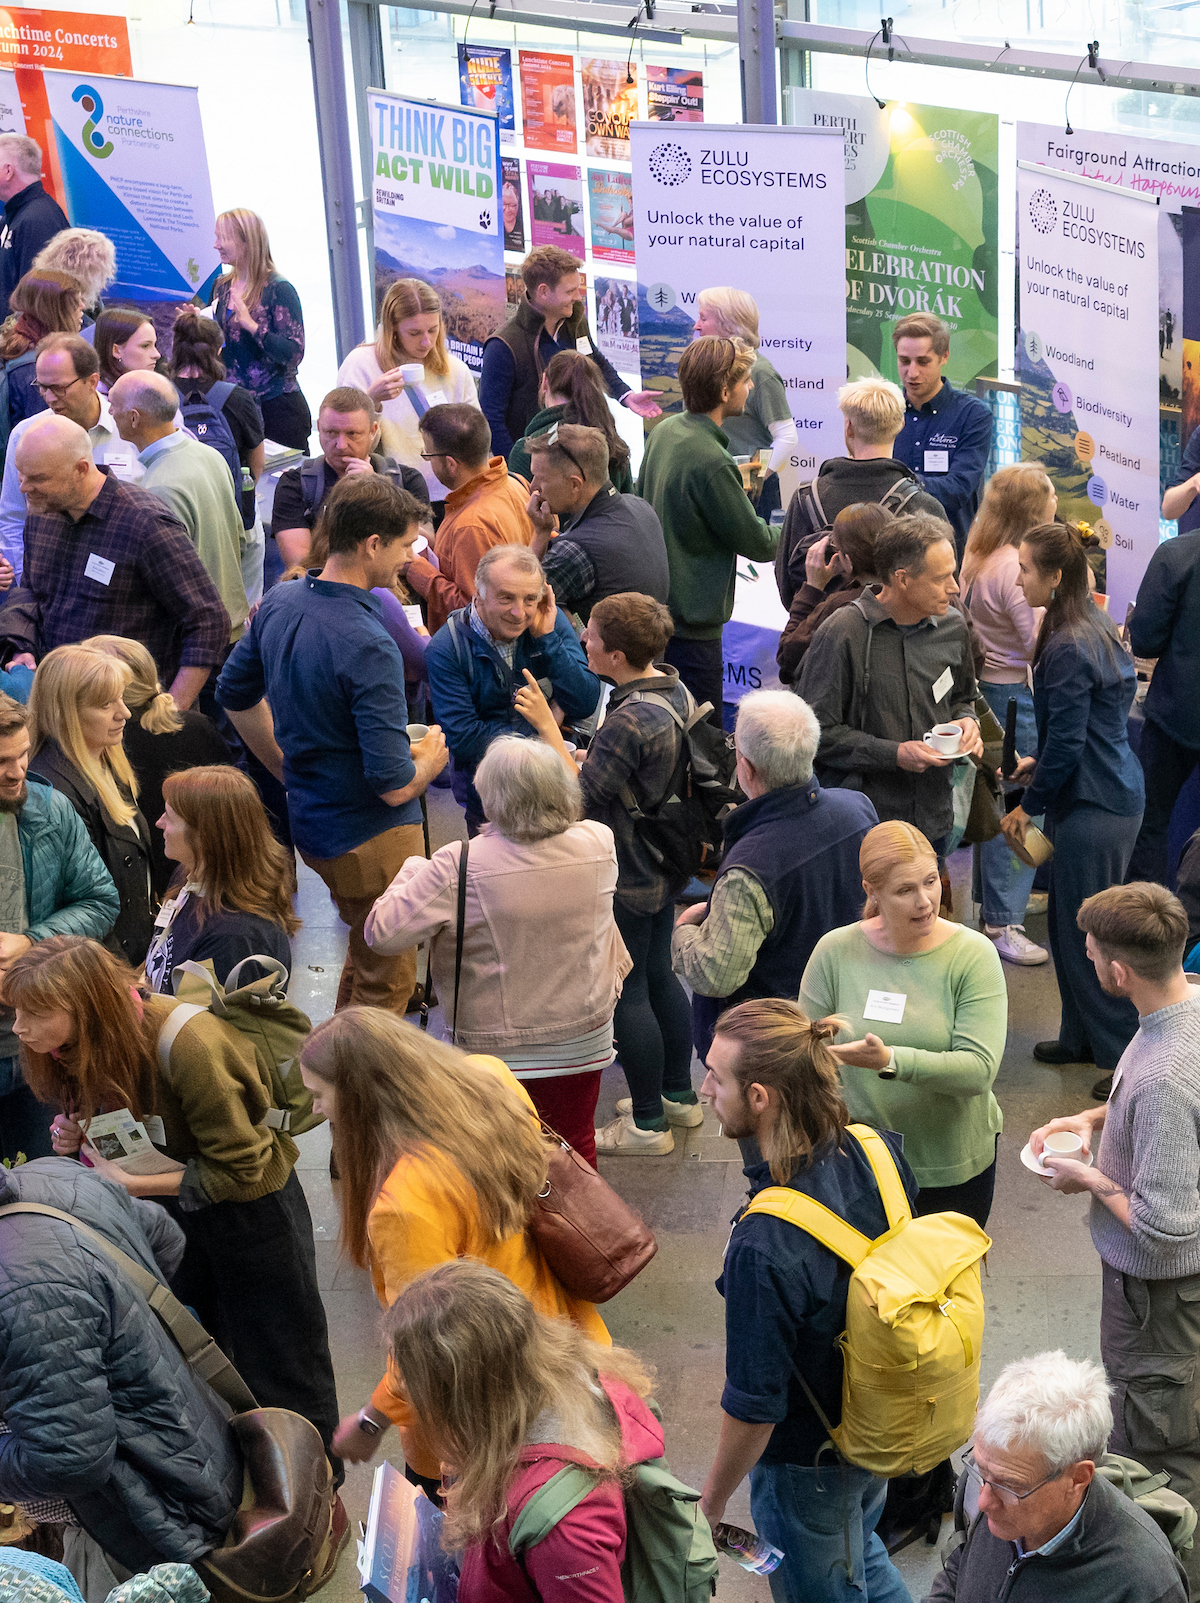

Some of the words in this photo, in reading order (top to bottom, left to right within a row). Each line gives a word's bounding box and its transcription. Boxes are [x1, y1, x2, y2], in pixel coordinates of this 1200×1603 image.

[55, 29, 118, 48] Concerts
[33, 44, 64, 61] 2024
[548, 59, 570, 67] Concerts
[649, 82, 665, 92] Kurt
[666, 84, 686, 96] Elling
[106, 115, 143, 127] nature
[588, 110, 604, 122] GO
[813, 114, 856, 131] PERTH
[108, 126, 174, 142] connections
[375, 102, 446, 160] THINK
[453, 118, 492, 169] BIG
[587, 123, 614, 137] OWN
[614, 125, 630, 138] WA
[929, 129, 971, 148] SCOTTISH
[700, 150, 748, 166] ZULU
[942, 139, 975, 177] CHAMBER
[1048, 142, 1127, 167] Fairground
[376, 151, 423, 184] ACT
[428, 162, 493, 199] WILD
[701, 169, 827, 189] ECOSYSTEMS
[936, 150, 968, 191] ORCHESTRA
[376, 188, 404, 201] REWILDING
[376, 198, 396, 206] BRITAIN
[648, 210, 704, 225] Unlock
[708, 213, 734, 226] the
[739, 215, 782, 228] value
[787, 216, 803, 229] of
[1062, 200, 1095, 223] ZULU
[648, 234, 684, 248] your
[689, 235, 745, 248] natural
[750, 236, 804, 252] capital
[852, 235, 877, 246] Scottish
[878, 239, 908, 251] Chamber
[910, 244, 942, 256] Orchestra
[1063, 221, 1145, 259] ECOSYSTEMS
[846, 249, 986, 291] ELEBRATION
[1027, 255, 1064, 278] Unlock
[1067, 268, 1083, 284] the
[1086, 276, 1115, 293] value
[1118, 284, 1128, 297] of
[869, 284, 963, 319] DVOŘÁK
[1027, 281, 1050, 296] your
[1052, 288, 1090, 308] natural
[1093, 300, 1129, 320] capital
[846, 305, 873, 318] ednesday
[875, 309, 883, 318] 25
[450, 340, 478, 356] BRITAIN
[761, 336, 812, 352] iversity
[463, 354, 483, 367] PEOP
[1046, 345, 1094, 370] Woodland
[783, 378, 824, 390] atland
[1076, 396, 1132, 428] Biodiversity
[790, 456, 816, 468] Soil
[1099, 445, 1141, 470] Peatland
[1110, 490, 1140, 512] Water
[1115, 534, 1134, 550] Soil
